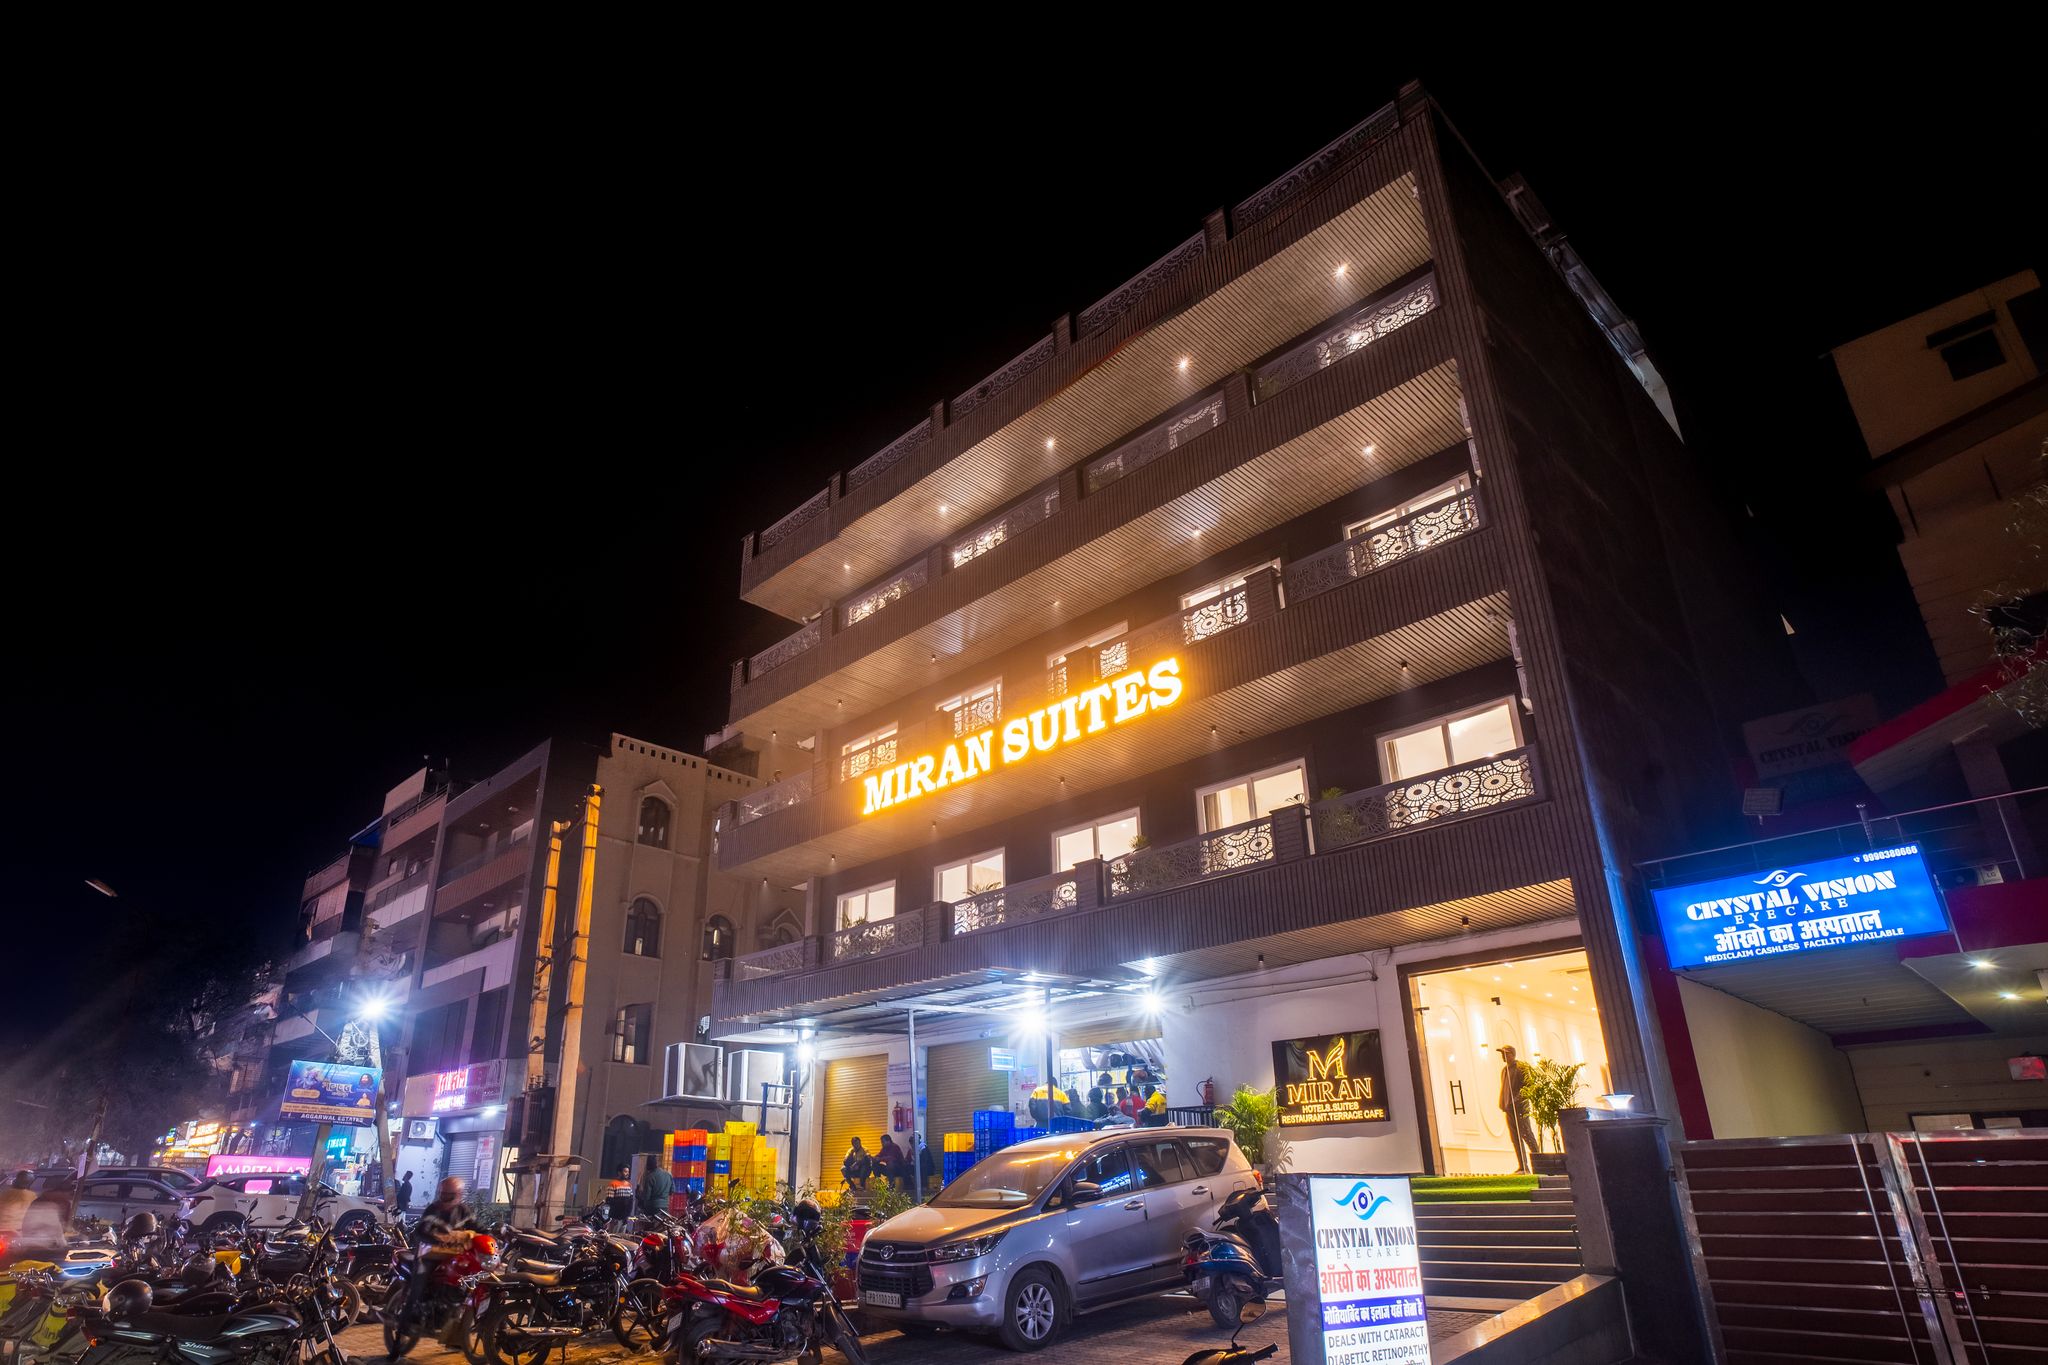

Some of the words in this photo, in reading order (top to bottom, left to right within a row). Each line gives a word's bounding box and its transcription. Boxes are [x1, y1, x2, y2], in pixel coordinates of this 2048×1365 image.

[863, 731, 994, 815] MIRAN
[1002, 657, 1183, 763] SUITES
[1686, 887, 1799, 921] CRYSTAL
[1801, 870, 1897, 902] VISION
[1767, 923, 1795, 944] का
[1797, 909, 1883, 941] अस्पताल
[1704, 949, 1754, 962] MEDICLAIM
[1755, 942, 1800, 956] CASHLESS
[1803, 936, 1846, 949] FACILITY
[1851, 927, 1905, 942] AVAILABLE
[1286, 1077, 1373, 1105] MIRAN
[301, 1112, 336, 1122] AGGARWAL
[1363, 1109, 1384, 1119] CAFE
[1316, 1227, 1373, 1249] CRYSTAL
[1374, 1226, 1415, 1247] VISION
[1355, 1269, 1371, 1292] का
[1373, 1266, 1419, 1290] अस्पताल
[1360, 1307, 1370, 1322] का
[1370, 1305, 1390, 1322] इलाज
[1414, 1297, 1423, 1316] है
[181, 1341, 214, 1350] Shine
[1328, 1333, 1356, 1348] DEALS
[1358, 1331, 1382, 1345] WITH
[1383, 1326, 1424, 1342] CATARACT
[1327, 1350, 1370, 1365] DIABETIC
[1372, 1343, 1428, 1362] RETINOPATHY
